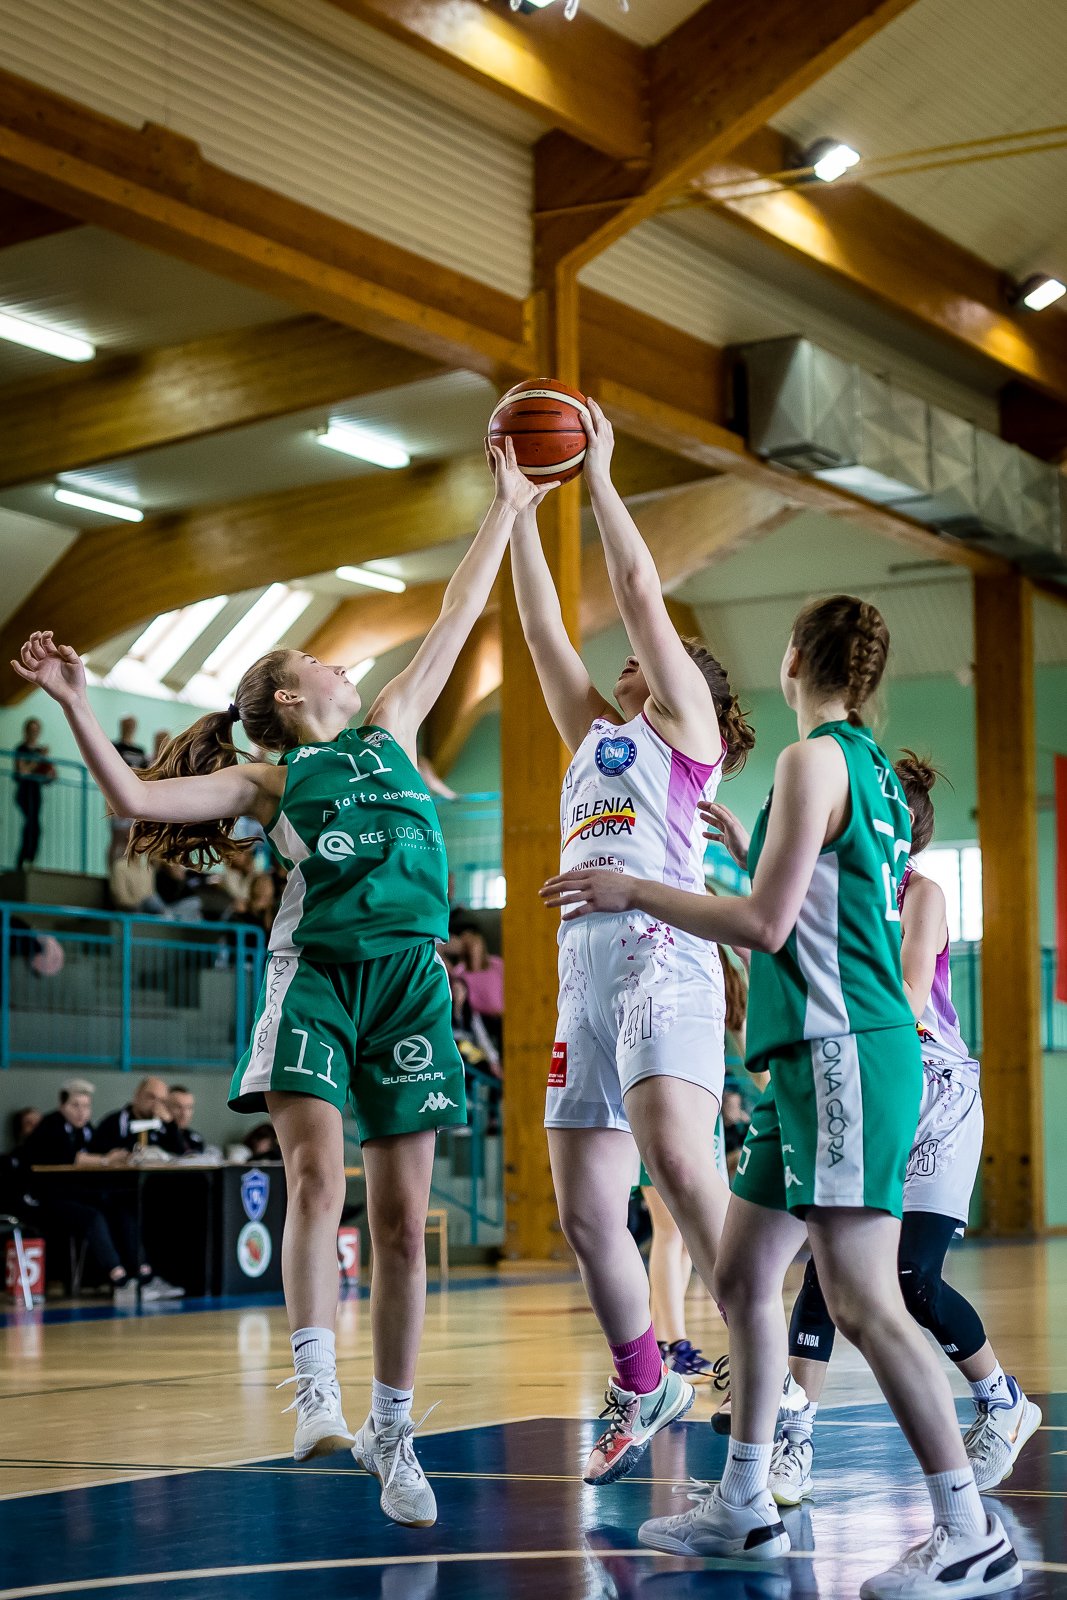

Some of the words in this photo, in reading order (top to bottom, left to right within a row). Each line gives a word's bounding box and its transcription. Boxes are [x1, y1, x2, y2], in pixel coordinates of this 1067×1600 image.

[336, 748, 393, 783] 11
[335, 792, 377, 809] fatto
[570, 797, 634, 827] JELENIA
[359, 830, 386, 844] ECE
[580, 816, 632, 840] GÓRA
[284, 1028, 338, 1088] 11
[826, 1098, 848, 1168] GÓRA
[803, 1333, 819, 1347] NBA
